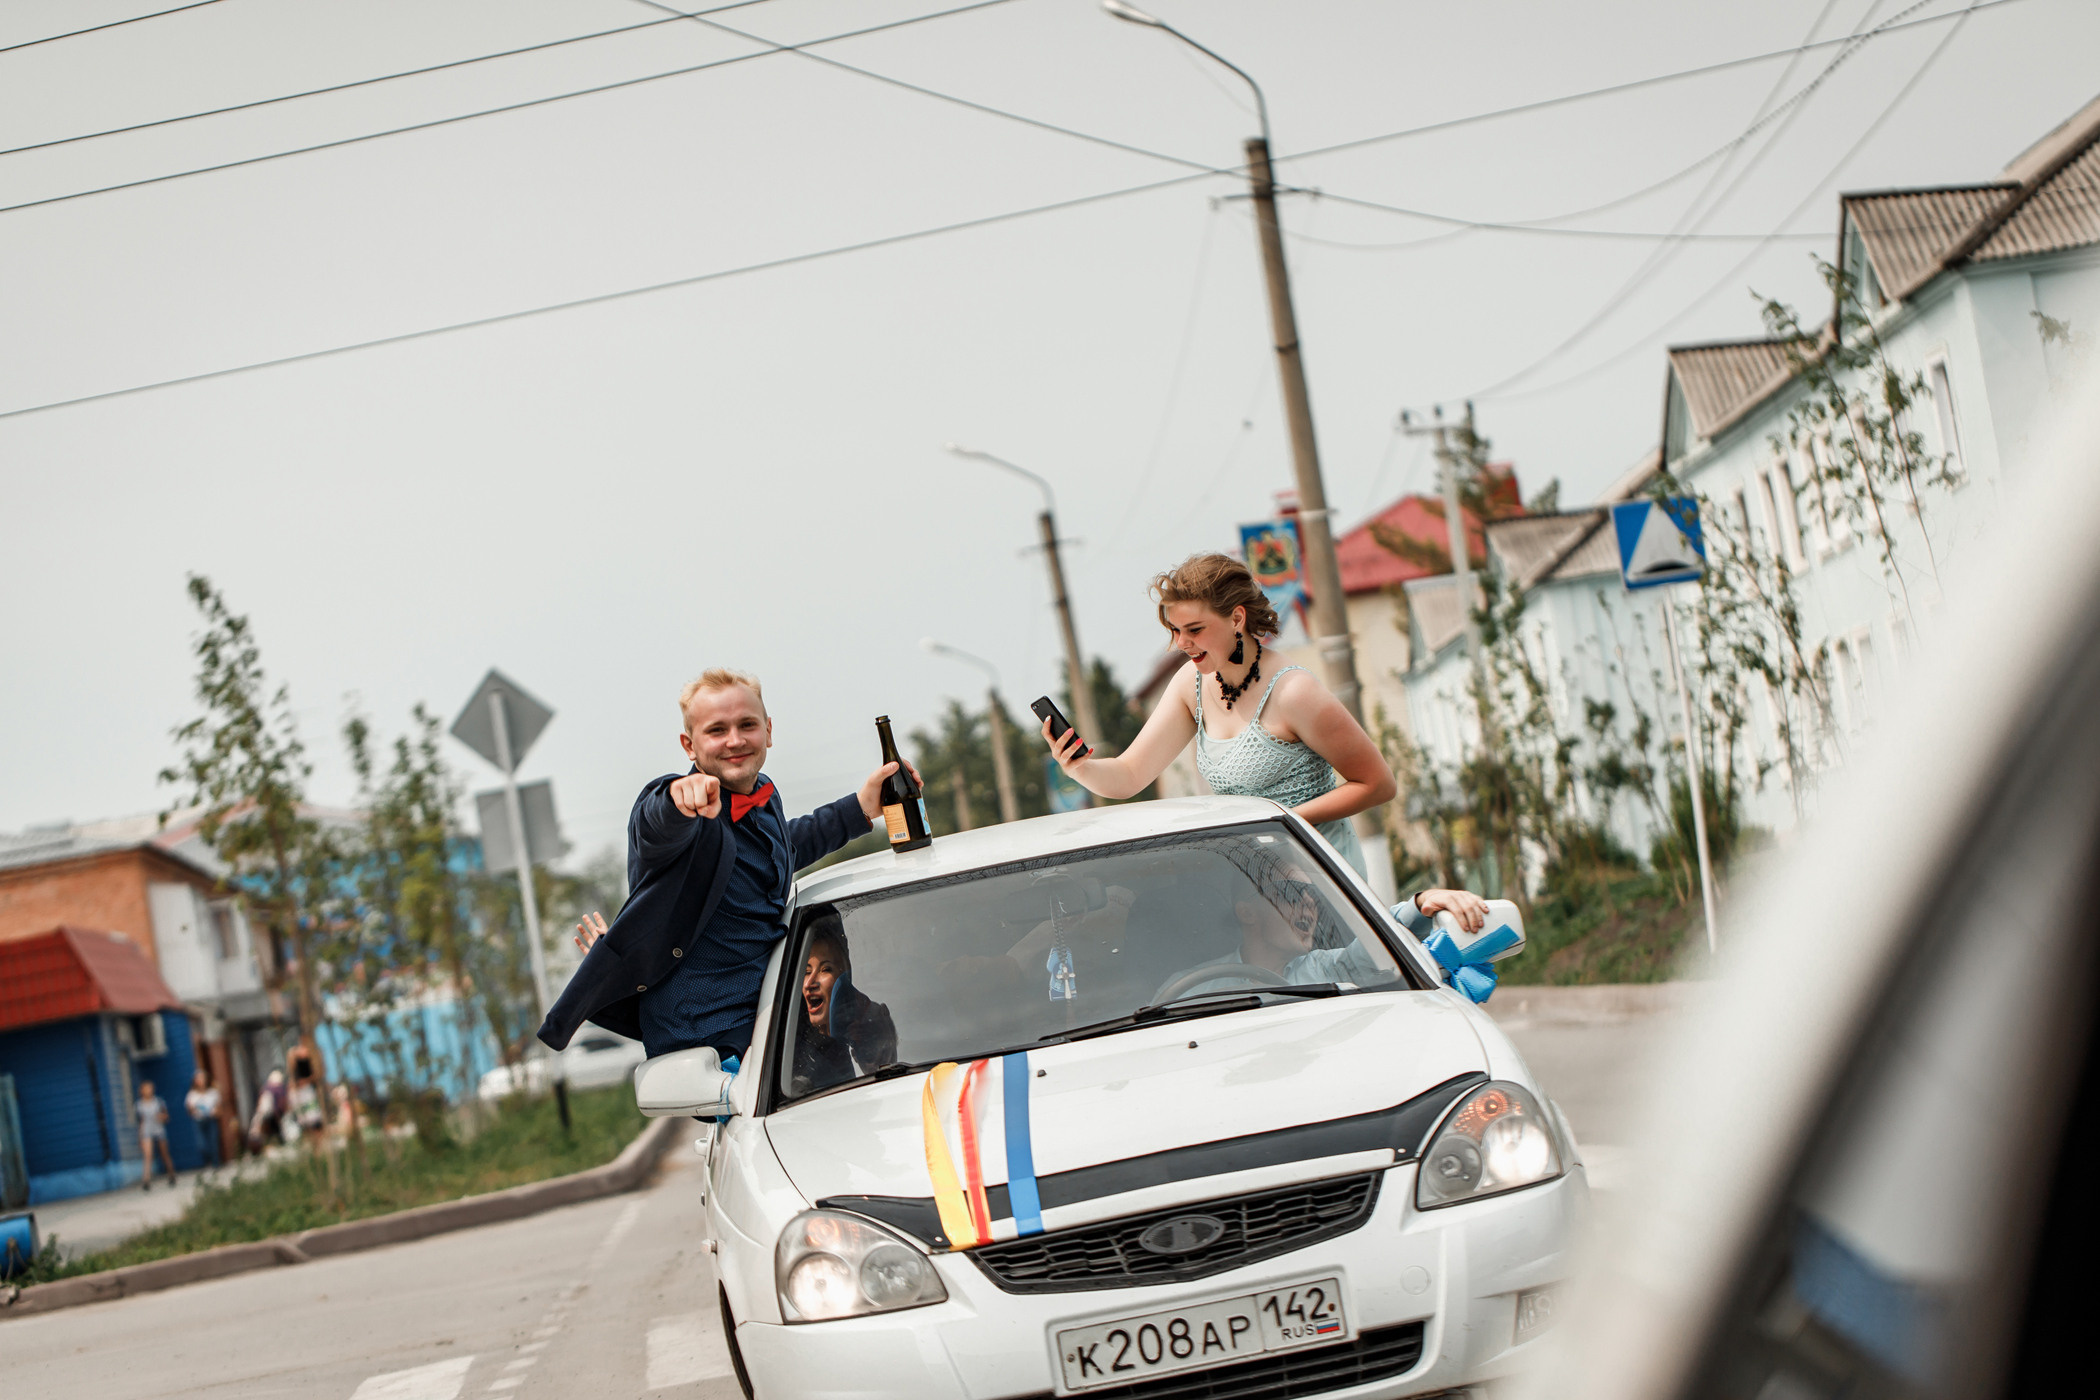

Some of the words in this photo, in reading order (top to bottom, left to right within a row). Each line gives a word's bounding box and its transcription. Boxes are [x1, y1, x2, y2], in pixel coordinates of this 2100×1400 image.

[1077, 1315, 1251, 1378] К208АР
[1262, 1287, 1329, 1327] 142
[1281, 1323, 1315, 1340] RUS
